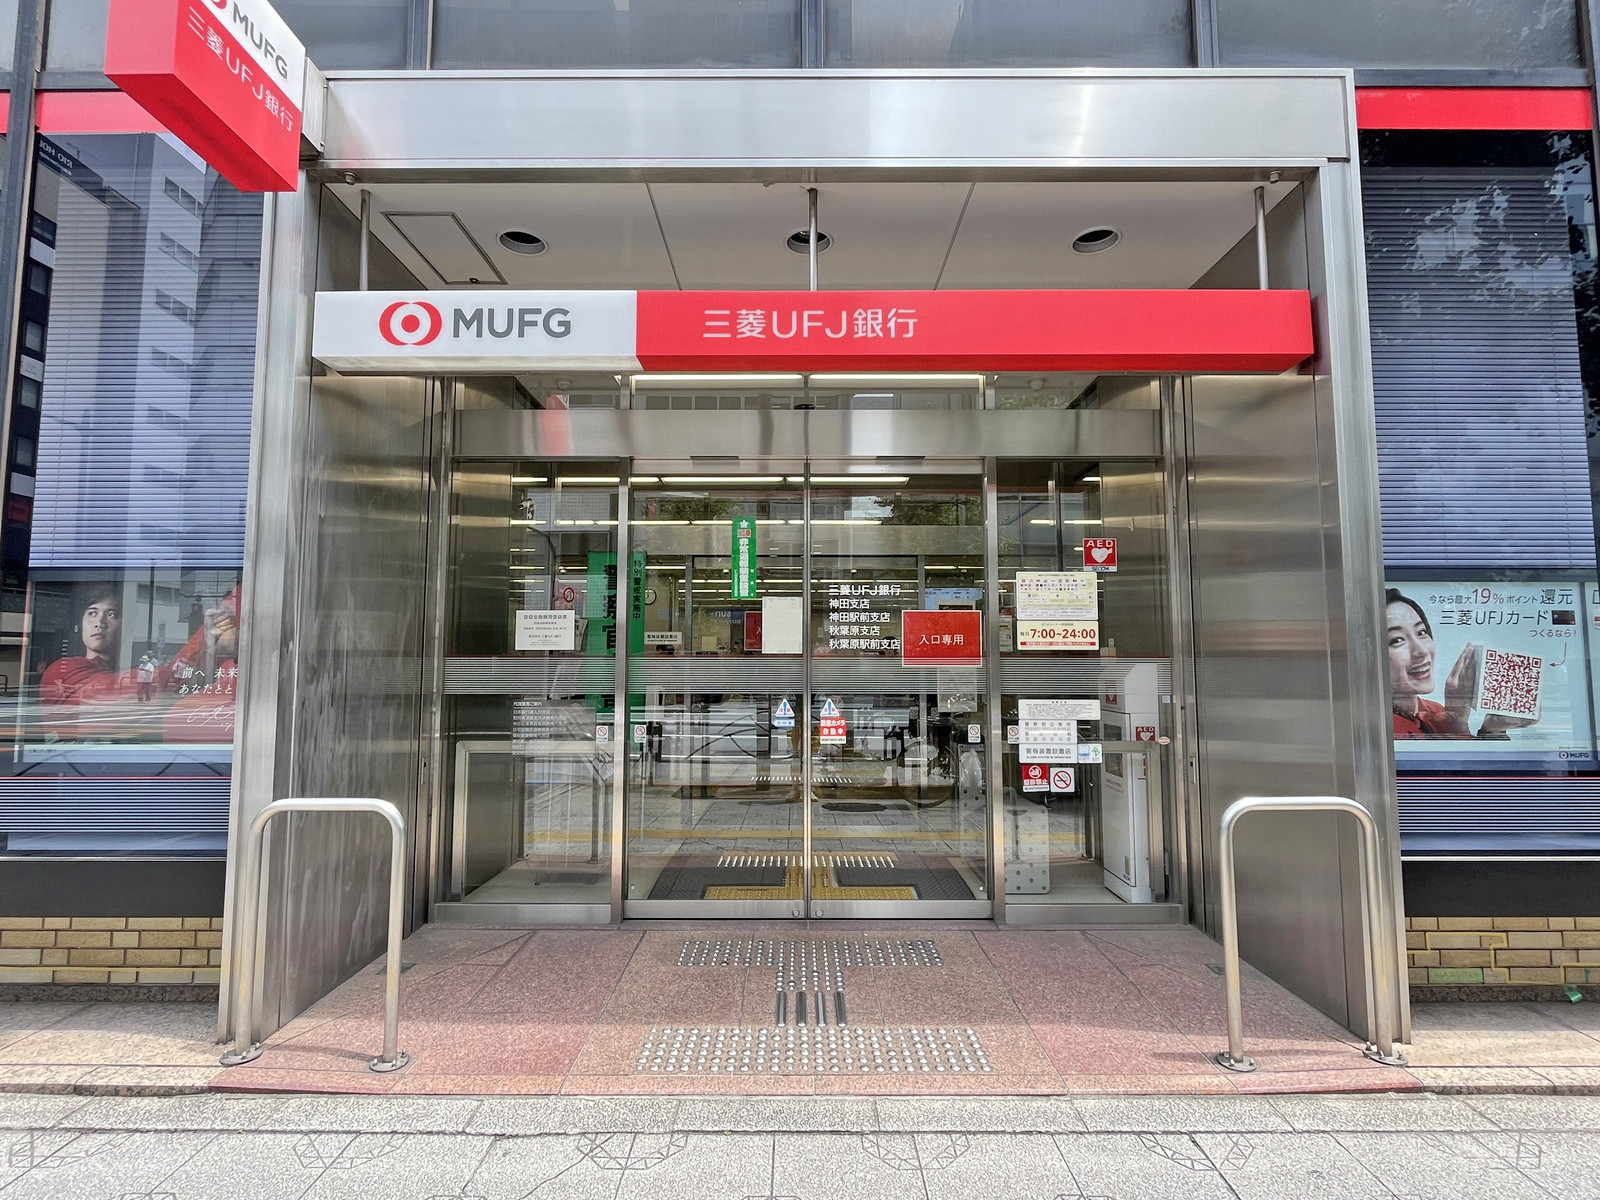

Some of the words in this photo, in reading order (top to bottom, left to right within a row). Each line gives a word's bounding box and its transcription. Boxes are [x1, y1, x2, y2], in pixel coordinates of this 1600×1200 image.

[233, 0, 288, 80] MUFG
[187, 5, 294, 132] 三菱UFJ銀行
[453, 307, 571, 338] MUFG
[703, 308, 918, 338] 三菱UFJ銀行
[632, 559, 643, 621] 特別警戒実施中
[828, 584, 901, 596] 三菱UFJ銀行
[828, 598, 870, 609] 神田支店
[828, 612, 890, 622] 神田駅前支店
[1439, 610, 1549, 626] 三菱UFJカード
[828, 625, 880, 636] 秋葉原支店
[828, 638, 901, 650] 秋葉原駅前支店
[918, 634, 964, 646] 入口専用
[182, 667, 206, 679] 前へ
[820, 719, 846, 727] 防犯カメラ
